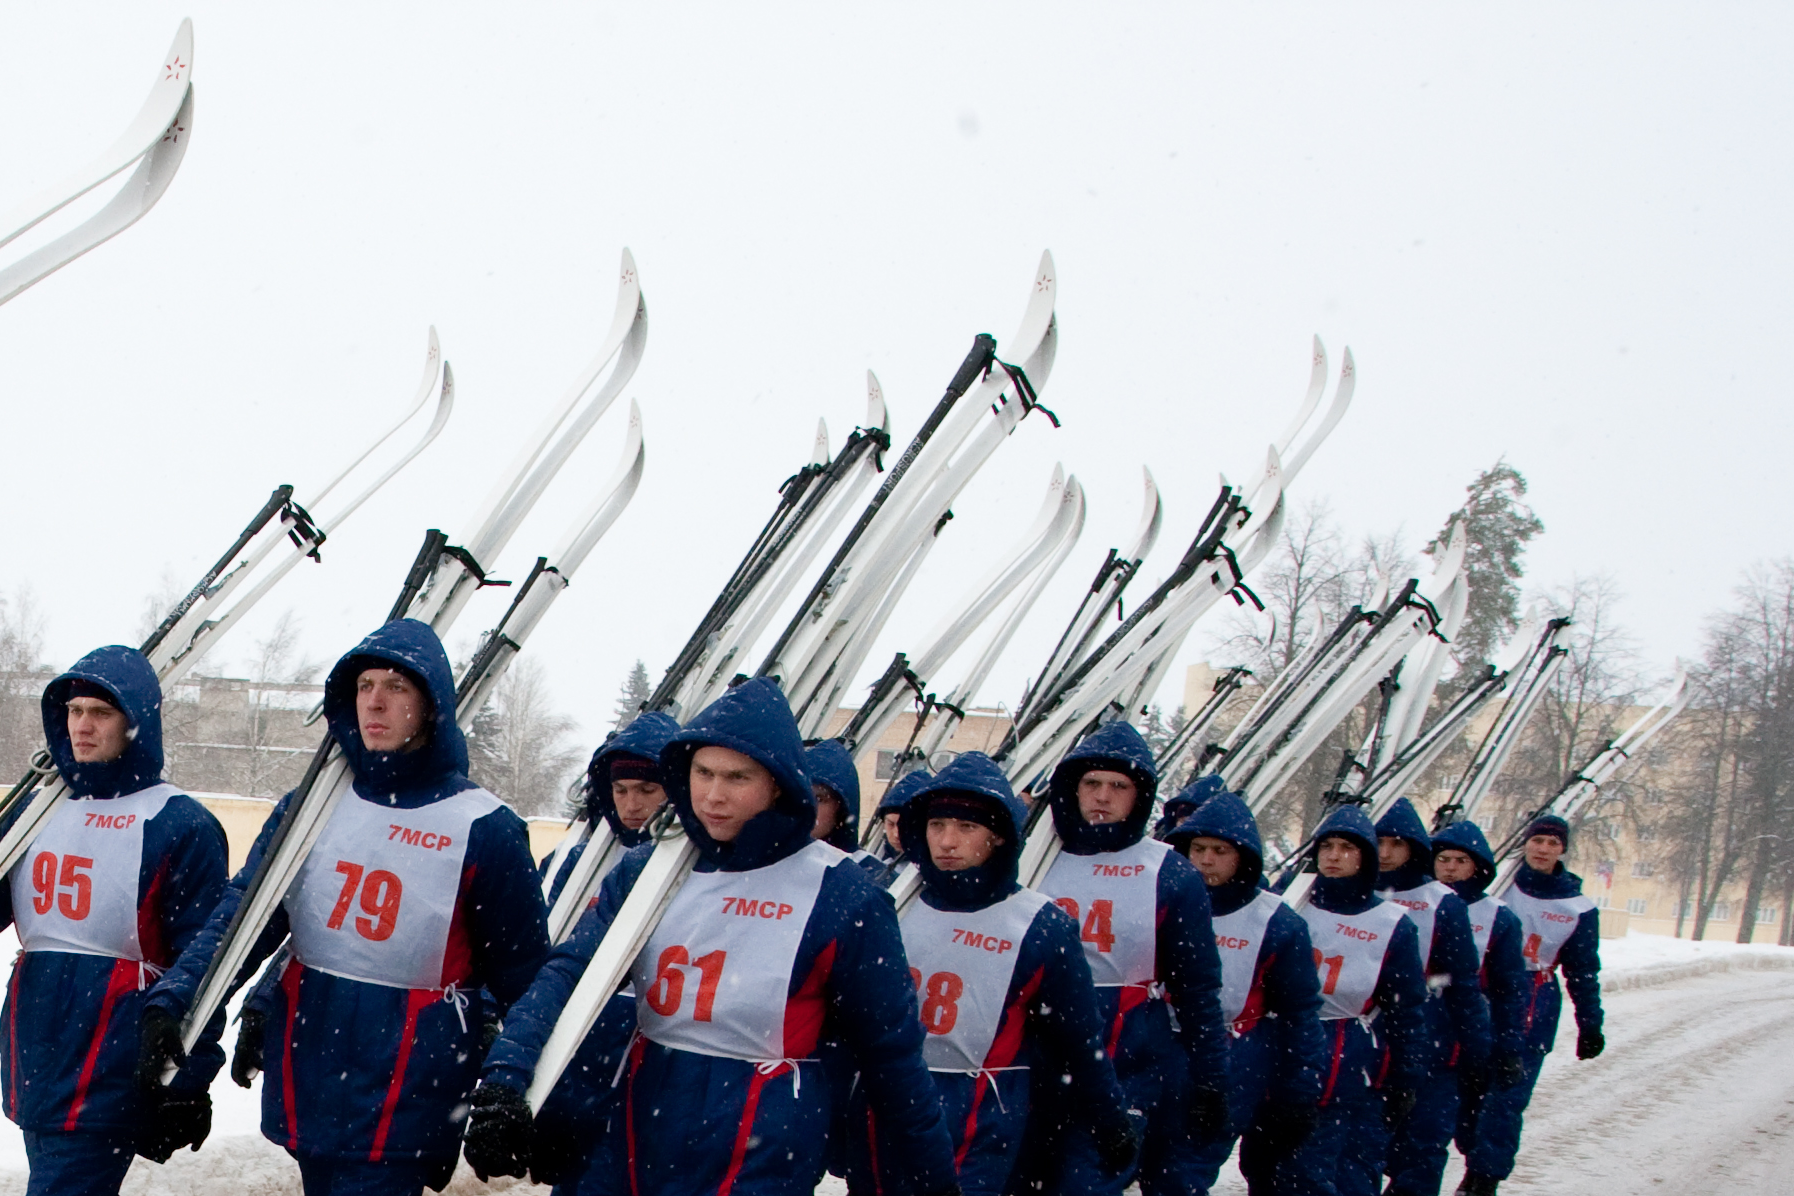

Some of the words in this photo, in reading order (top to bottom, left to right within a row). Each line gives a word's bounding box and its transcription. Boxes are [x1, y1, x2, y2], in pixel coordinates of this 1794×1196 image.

[33, 850, 94, 921] 95
[326, 860, 403, 942] 79
[645, 944, 727, 1023] 61
[908, 966, 964, 1036] 8
